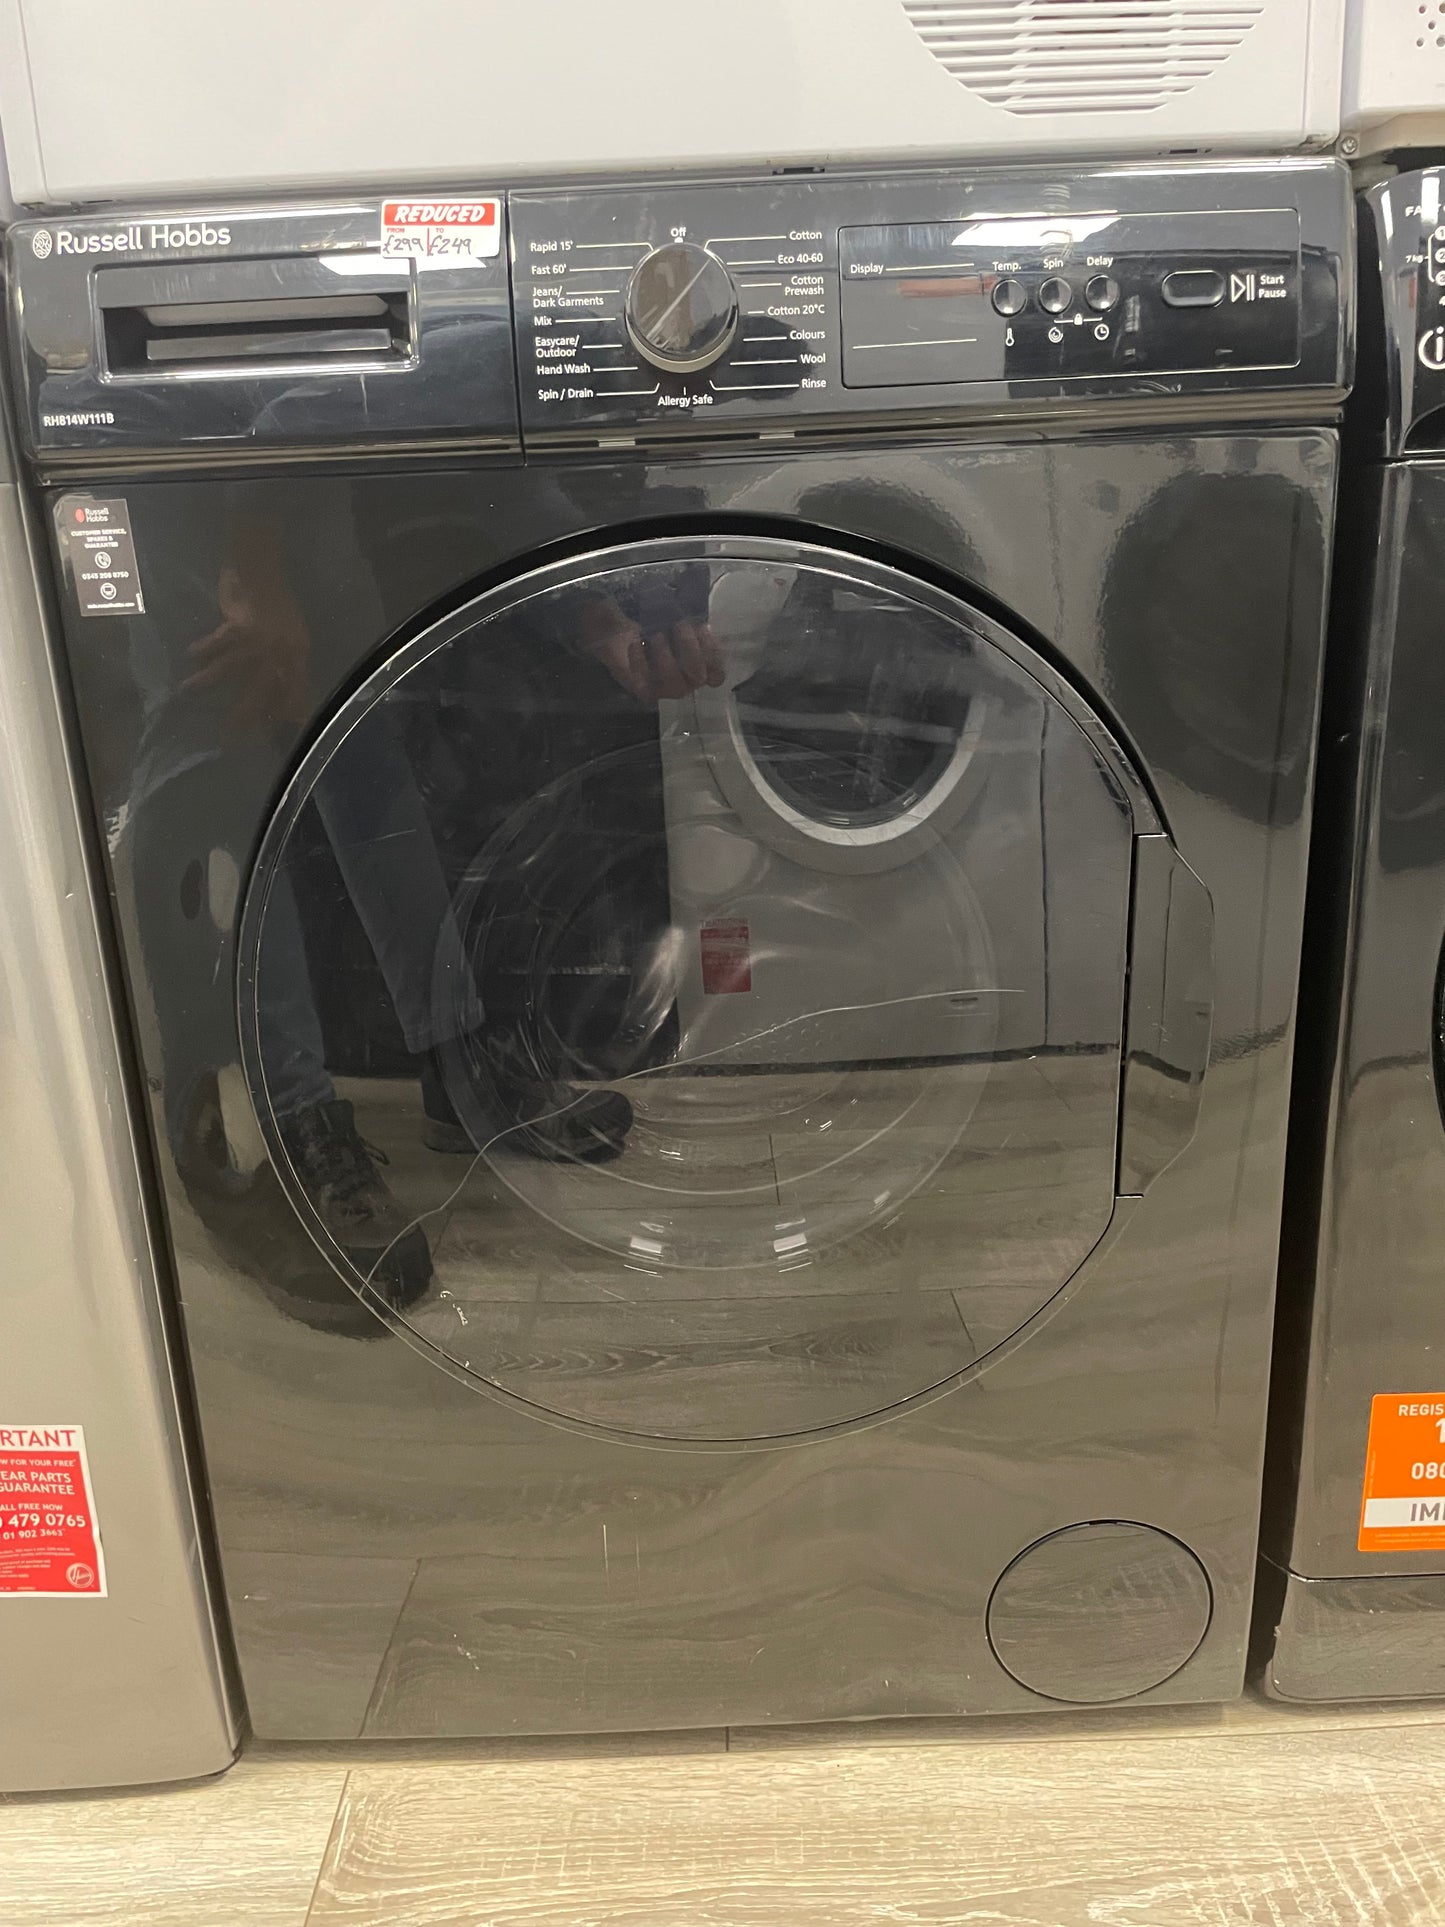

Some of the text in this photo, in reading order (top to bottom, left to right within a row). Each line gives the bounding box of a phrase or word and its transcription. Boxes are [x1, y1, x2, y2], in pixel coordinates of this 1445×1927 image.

[394, 205, 486, 223] REDUCED
[670, 227, 687, 237] Off
[789, 231, 822, 240] Cotton
[57, 223, 231, 254] Russell Hobbs
[383, 235, 424, 254] £299
[428, 235, 472, 256] £249
[530, 240, 574, 254] Rapid 15'
[777, 253, 823, 264] Eco 40-60
[1043, 258, 1064, 269] Spin
[1086, 256, 1114, 268] Delay
[531, 265, 567, 275] Fast 60'
[850, 263, 884, 275] Display
[992, 261, 1022, 272] Temp.
[791, 276, 824, 285] Cotton
[1260, 275, 1284, 285] Start
[532, 286, 563, 297] Jeans/
[784, 286, 825, 296] Prewash
[1258, 288, 1287, 299] Pause
[533, 296, 604, 308] Dark Garments
[767, 304, 825, 316] Cotton 20°C
[534, 316, 552, 326] Mix
[535, 334, 580, 347] Easycare/
[789, 330, 826, 340] Colours
[535, 348, 577, 358] Outdoor
[800, 353, 826, 363] Wool
[536, 363, 591, 375] Hand Wash
[801, 378, 827, 388] Rinse
[538, 389, 559, 401] Spin
[567, 388, 594, 399] Drain
[657, 394, 714, 407] Allergy Safe
[43, 412, 115, 427] RH814W111B
[1398, 1404, 1444, 1416] REGIS
[0, 1430, 76, 1446] RTANT
[0, 1471, 71, 1483] EAR PARTS
[0, 1482, 75, 1495] GUARANTEE
[1410, 1503, 1445, 1521] IM
[8, 1513, 40, 1527] 479
[45, 1514, 86, 1527] 0765
[3, 1532, 15, 1540] 01
[18, 1530, 37, 1538] 902
